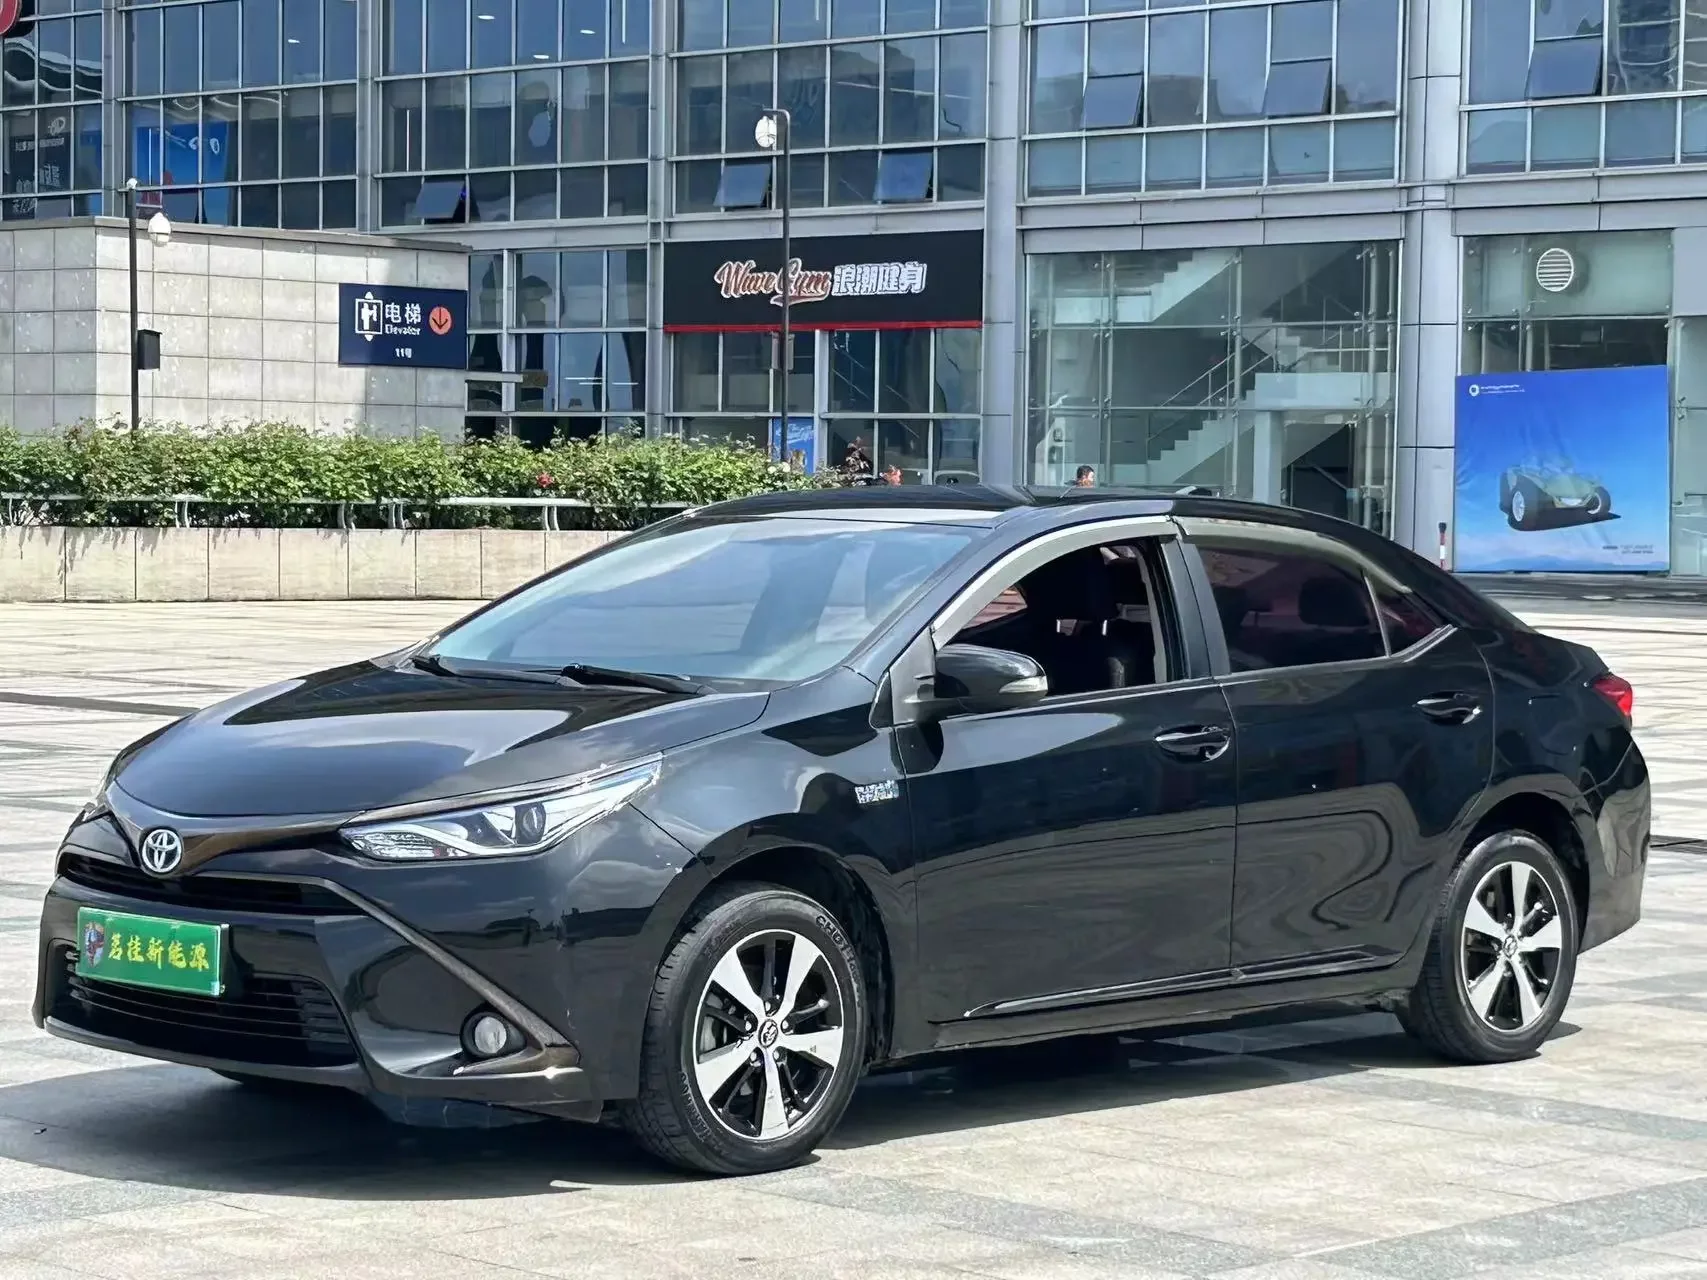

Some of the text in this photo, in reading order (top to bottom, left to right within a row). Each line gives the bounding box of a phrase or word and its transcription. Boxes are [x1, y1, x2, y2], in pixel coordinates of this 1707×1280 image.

[831, 261, 928, 297] 浪潮健身
[385, 302, 421, 324] 电梯
